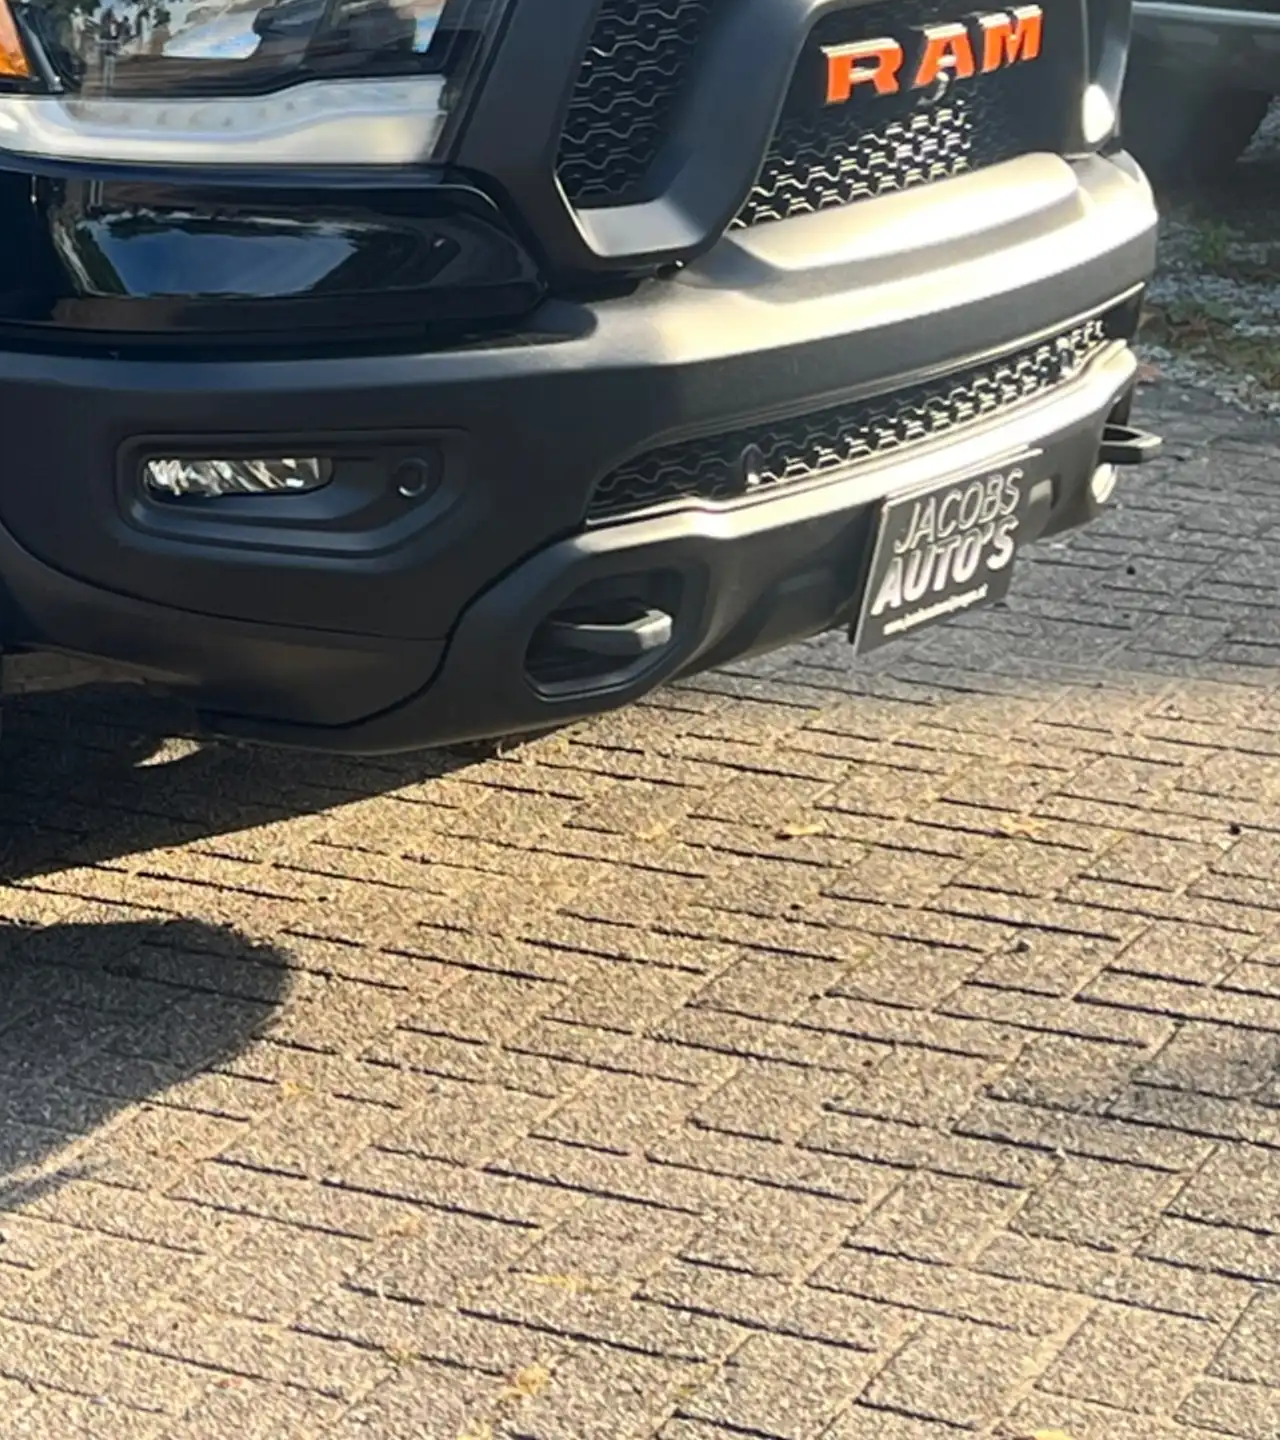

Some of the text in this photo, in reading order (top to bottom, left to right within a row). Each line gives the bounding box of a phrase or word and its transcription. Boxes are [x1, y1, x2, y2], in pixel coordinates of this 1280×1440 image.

[819, 4, 1043, 104] RAM
[893, 467, 1024, 554] JACOBS
[869, 514, 1020, 616] AUTO'S
